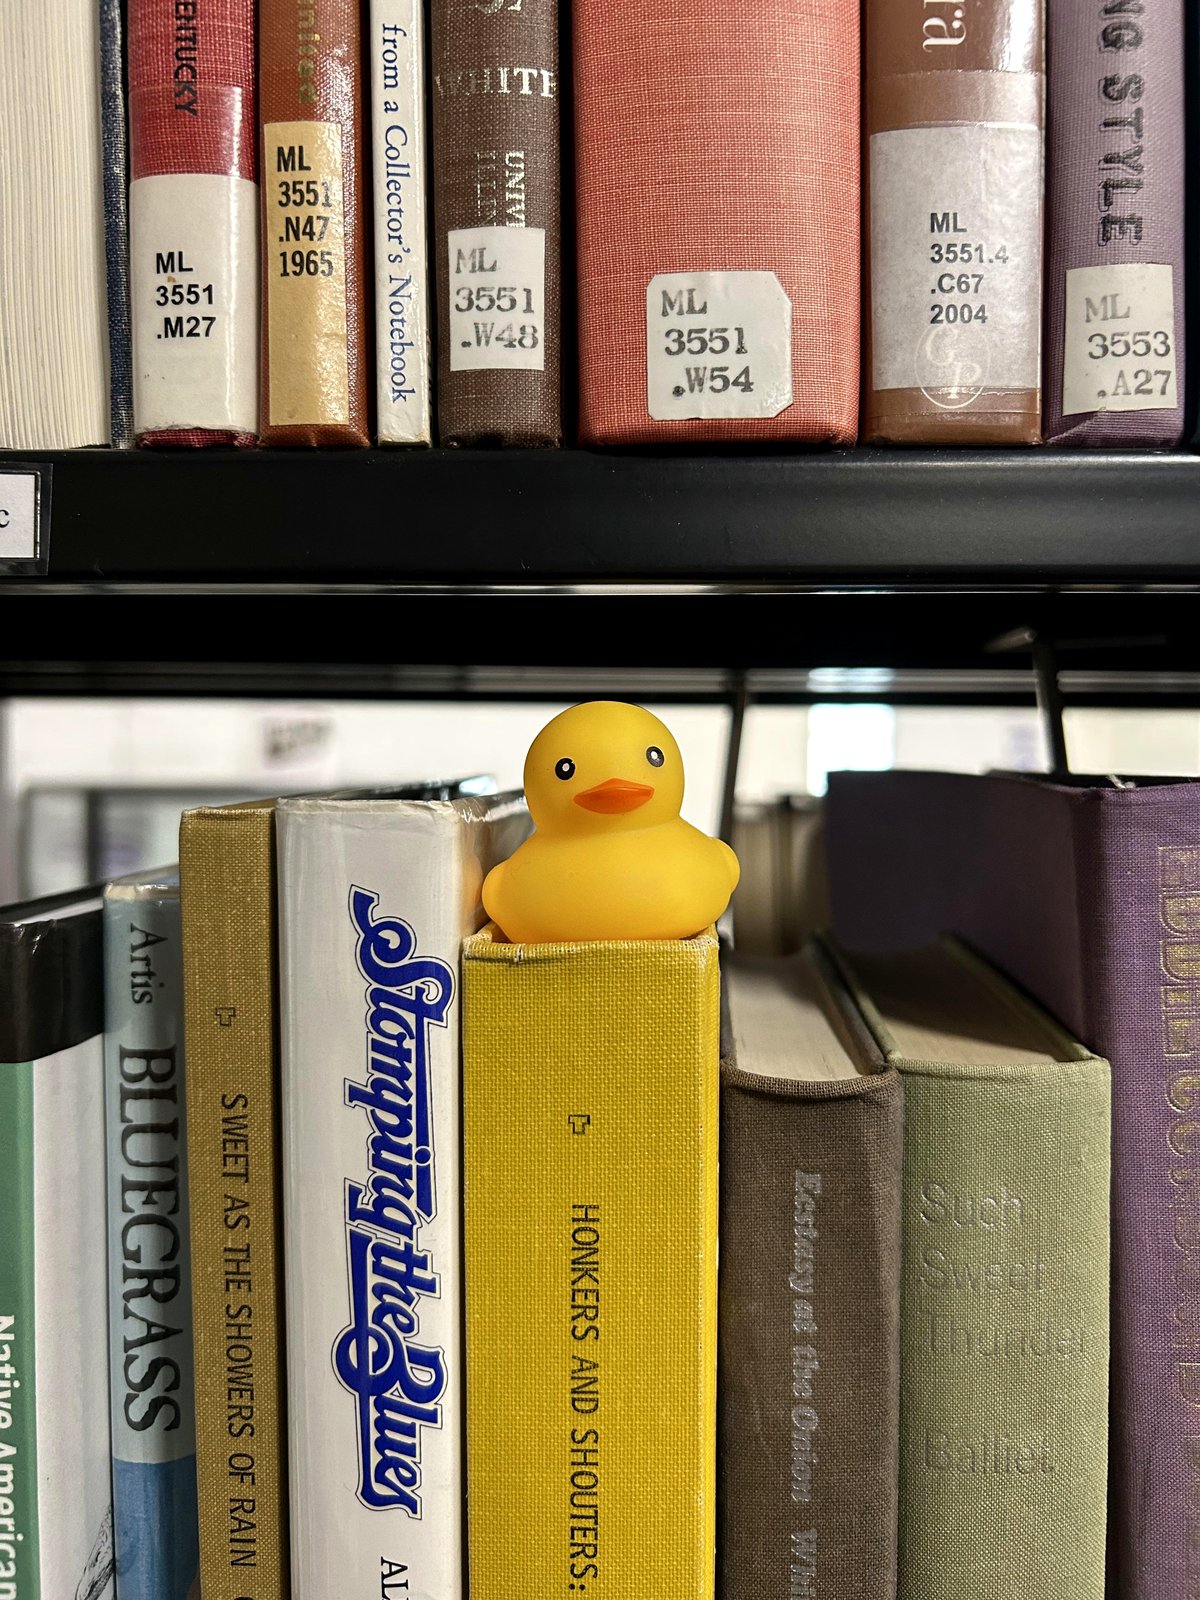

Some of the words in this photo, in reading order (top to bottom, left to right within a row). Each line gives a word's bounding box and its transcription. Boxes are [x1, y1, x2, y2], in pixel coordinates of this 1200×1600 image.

[382, 23, 407, 90] from
[383, 100, 399, 114] a
[276, 145, 312, 172] ML
[1097, 73, 1146, 248] STYLE
[277, 180, 333, 208] 3551
[385, 124, 411, 264] Collector's
[278, 215, 330, 242] .N47
[930, 212, 967, 233] ML
[156, 251, 194, 274] ML
[279, 249, 334, 277] 1965
[455, 247, 498, 274] ML
[930, 243, 1009, 264] 3551.4
[156, 283, 213, 307] 3551
[455, 286, 535, 314] 3551
[661, 288, 708, 317] ML
[930, 273, 985, 294] .C67
[157, 316, 217, 339] .M27
[930, 303, 988, 324] 2004
[1085, 292, 1131, 323] ML
[388, 274, 416, 404] Notebook
[461, 322, 539, 349] .W48
[664, 327, 748, 356] 3551
[1088, 330, 1171, 360] 3553
[672, 365, 755, 397] .W54
[1097, 368, 1172, 398] .A27
[129, 922, 169, 1005] Artis
[345, 884, 456, 1240] Stomping
[221, 1093, 249, 1184] SWEET
[223, 1193, 251, 1230] AS
[920, 1183, 1024, 1228] Such
[118, 1044, 184, 1434] BLUEGRASS
[788, 1169, 822, 1293] Ecstasy
[223, 1242, 252, 1292] THE
[571, 1204, 600, 1341] HONKERS
[920, 1246, 1046, 1292] Sweet
[372, 1236, 441, 1340] the
[793, 1298, 818, 1333] at
[921, 1312, 1086, 1359] Thunder
[0, 1315, 20, 1430] Native
[226, 1303, 255, 1438] SHOWERS
[570, 1355, 599, 1415] AND
[792, 1343, 820, 1397] the
[332, 1270, 449, 1520] Blues
[228, 1452, 256, 1486] OF
[791, 1405, 819, 1502] Onion
[568, 1428, 599, 1591] SHOUTERS:
[229, 1498, 257, 1567] RAIN
[380, 1556, 409, 1600] AL
